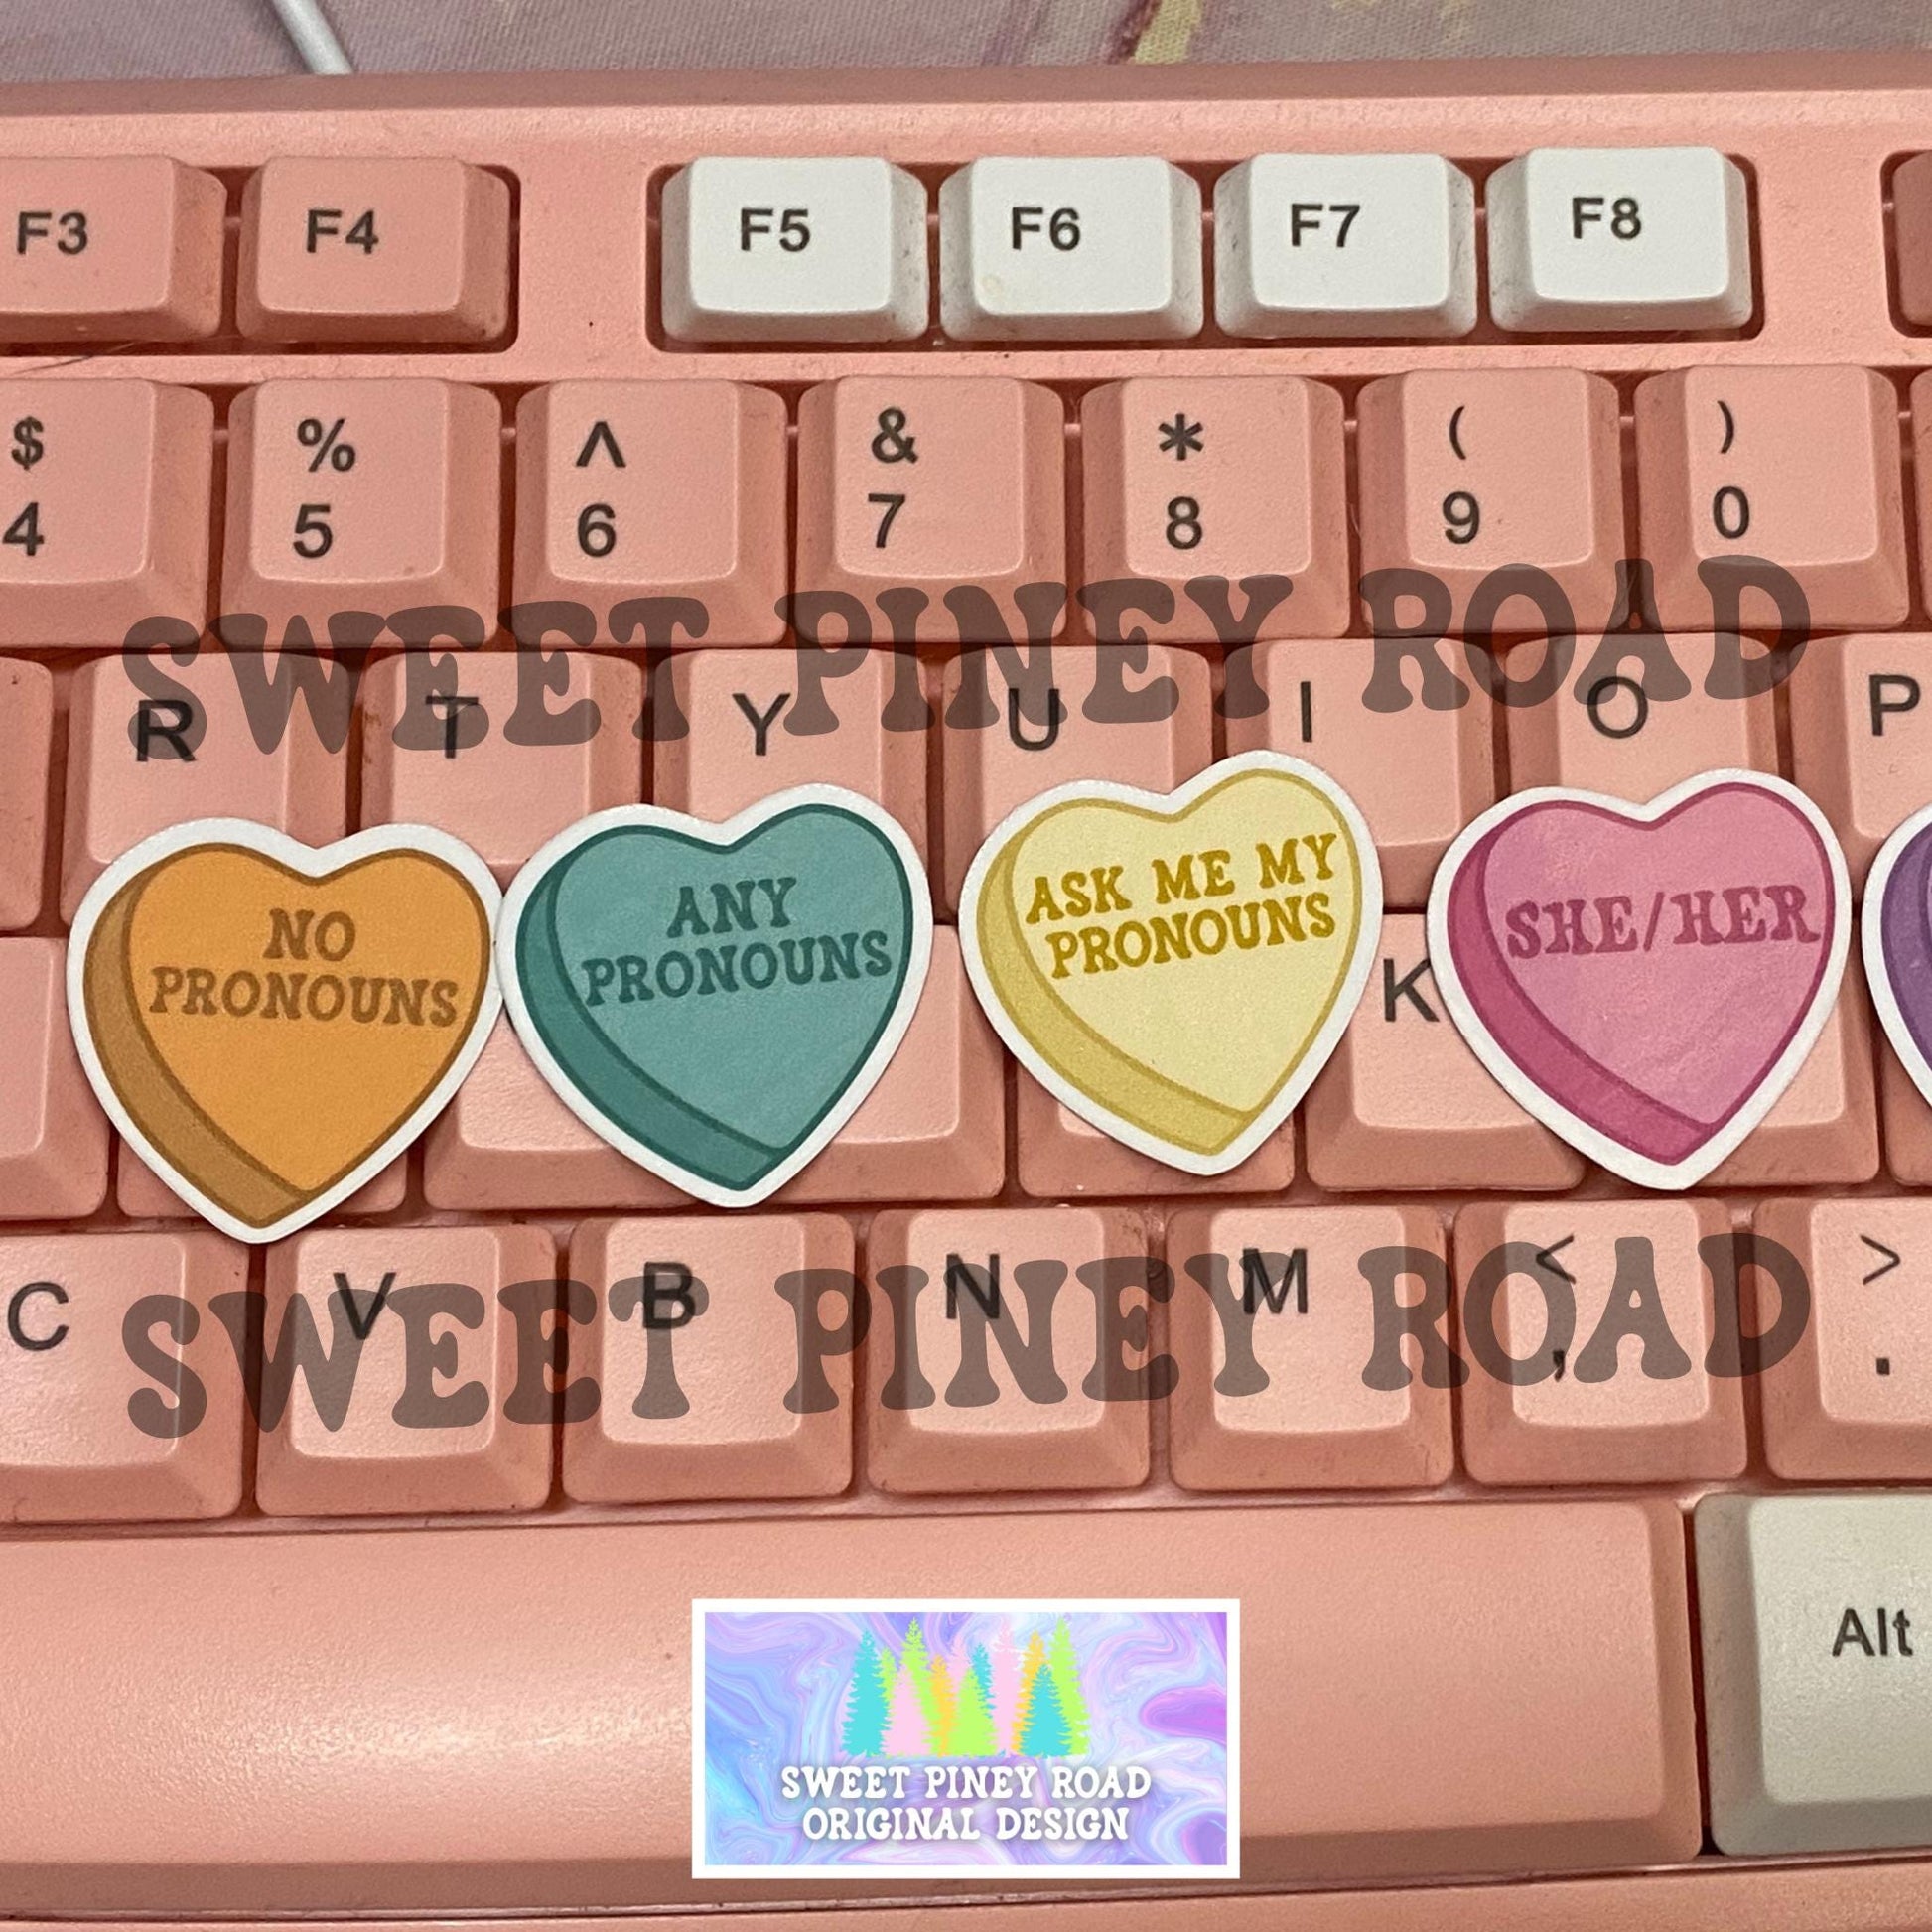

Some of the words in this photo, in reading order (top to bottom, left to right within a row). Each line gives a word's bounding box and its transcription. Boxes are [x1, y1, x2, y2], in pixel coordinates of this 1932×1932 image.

[17, 211, 88, 254] F3
[306, 208, 378, 253] F4
[739, 207, 811, 252] F5
[1011, 207, 1081, 251] F6
[1290, 203, 1360, 248] F7
[1571, 197, 1642, 239] F8
[11, 416, 44, 469] $
[297, 418, 356, 473] %
[871, 407, 918, 463] &
[1449, 405, 1465, 460] (
[1717, 400, 1734, 454] )
[2, 502, 45, 556] 4
[293, 504, 333, 558] 5
[577, 503, 617, 558] 6
[867, 493, 905, 548] 7
[1166, 496, 1203, 550] 8
[1442, 491, 1480, 544] 9
[1712, 486, 1749, 539] 0
[135, 699, 196, 762] R
[425, 696, 479, 759] T
[732, 693, 790, 756] Y
[1008, 687, 1060, 751] U
[1301, 681, 1312, 743] I
[1587, 675, 1648, 739] O
[1868, 674, 1920, 736] P
[1026, 865, 1132, 925] ASK
[1151, 850, 1232, 904] ME
[1256, 832, 1337, 889] MY
[262, 908, 356, 961] NO
[666, 877, 797, 938] ANY
[1505, 884, 1821, 960] SHE/HER
[1045, 892, 1336, 979] PRONOUNS
[580, 929, 892, 1008] PRONOUNS
[1383, 958, 1440, 1023] K
[148, 966, 459, 1028] PRONOUNS
[945, 1253, 1000, 1320] N
[1242, 1248, 1308, 1314] M
[1535, 1234, 1576, 1284] <
[1861, 1235, 1901, 1286] >
[7, 1282, 69, 1350] C
[333, 1272, 396, 1340] V
[642, 1261, 695, 1330] B
[1831, 1608, 1913, 1657] Alt
